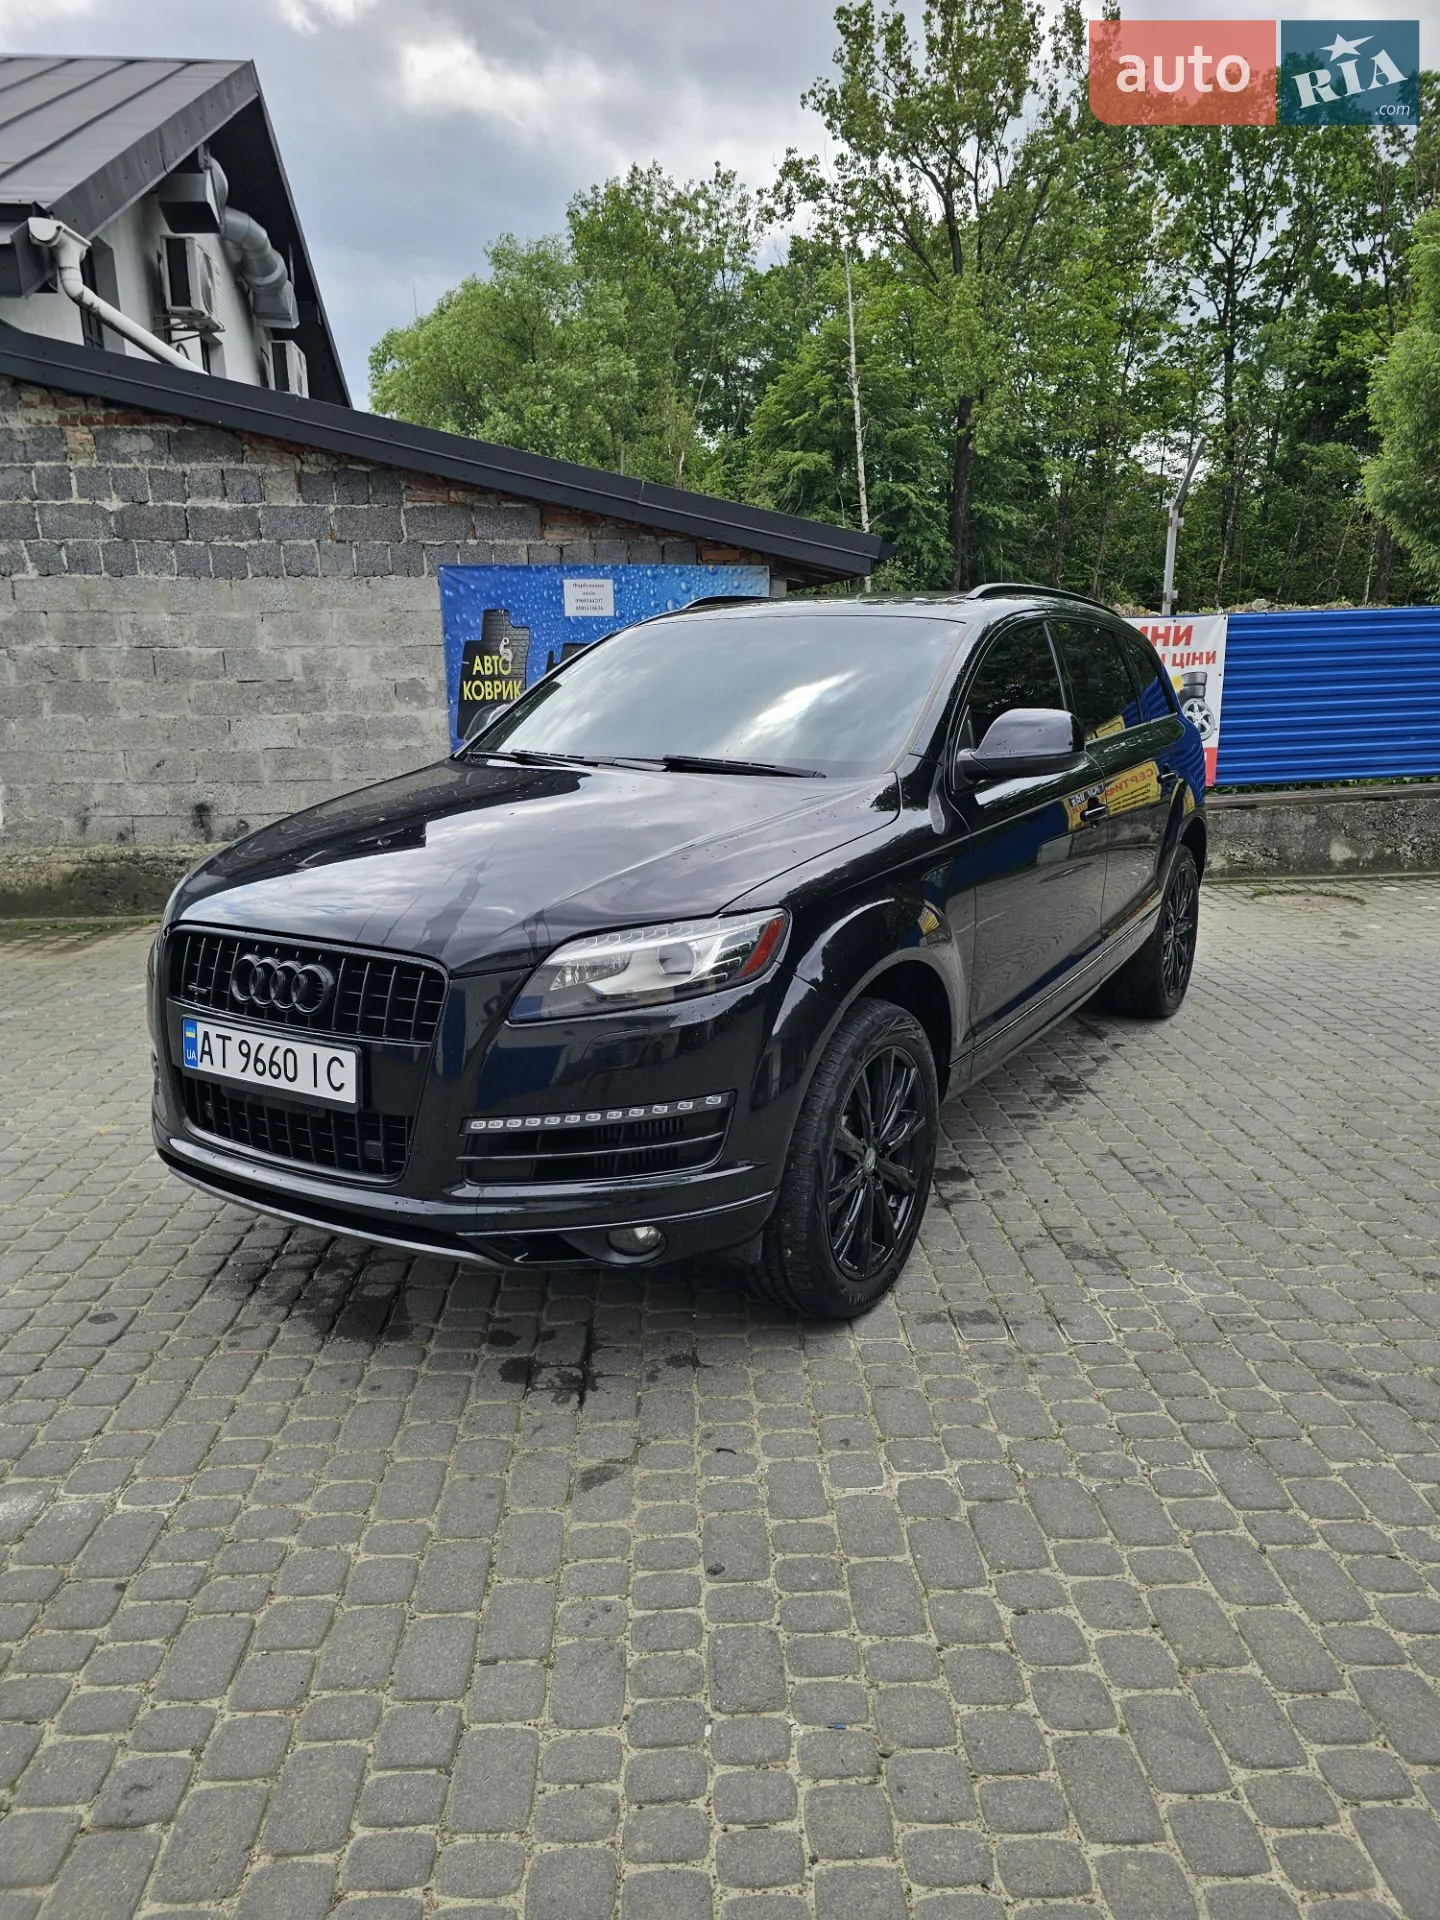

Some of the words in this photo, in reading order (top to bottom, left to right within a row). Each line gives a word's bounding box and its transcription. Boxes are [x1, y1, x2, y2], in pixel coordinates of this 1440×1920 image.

[472, 655, 512, 676] АВТО
[1171, 651, 1217, 669] ЦІНИ
[463, 680, 522, 701] КОВРИК
[186, 1049, 197, 1061] UA
[199, 1030, 232, 1069] AT
[238, 1039, 298, 1083] 9660
[313, 1052, 345, 1092] IC
